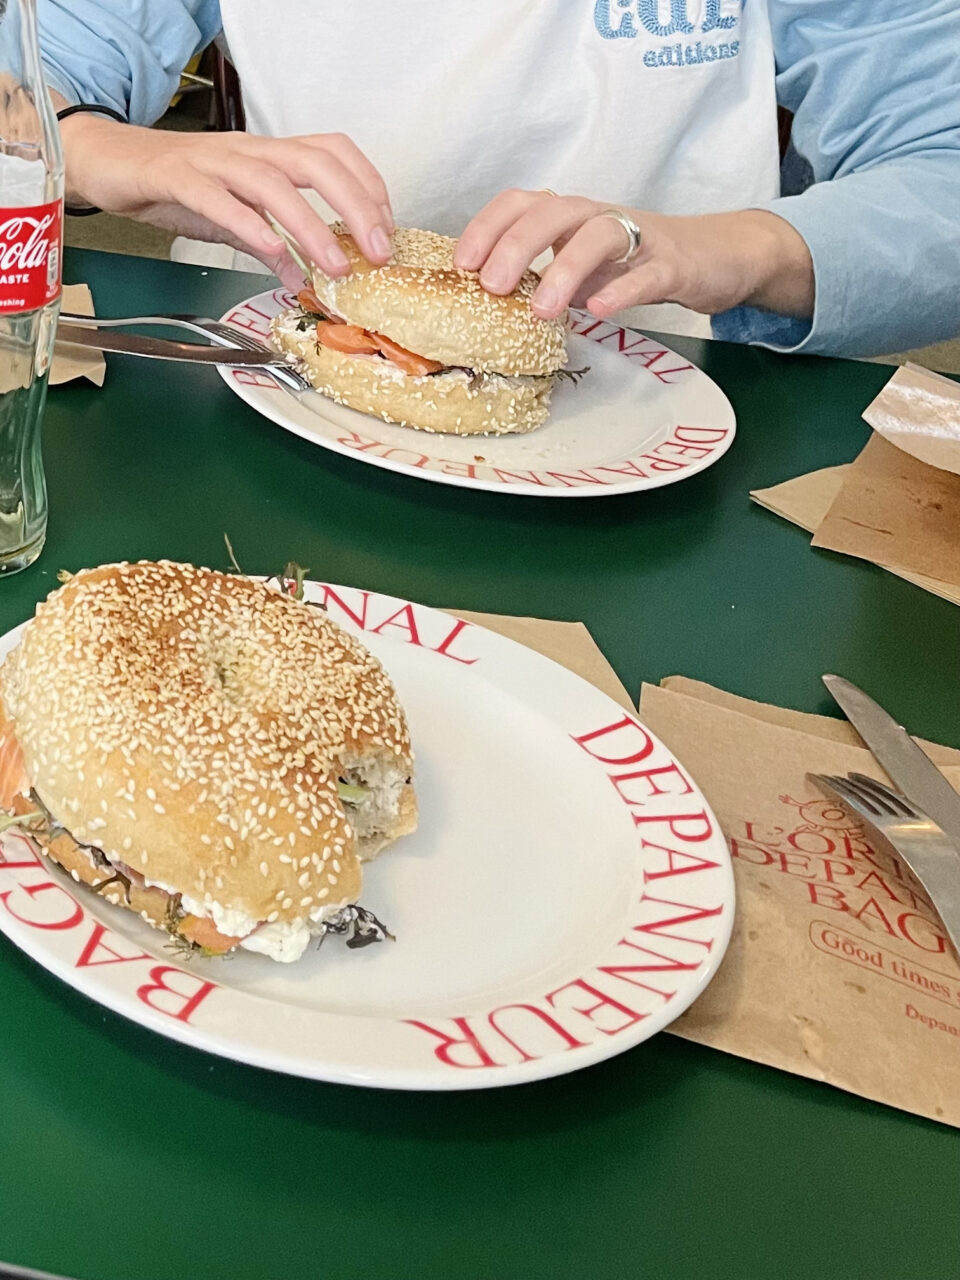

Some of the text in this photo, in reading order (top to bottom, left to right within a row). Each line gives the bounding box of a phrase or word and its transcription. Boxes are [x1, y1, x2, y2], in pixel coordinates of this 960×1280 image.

[336, 425, 729, 487] DEPANNEUR
[398, 712, 724, 1069] DEPANNEUR
[802, 881, 946, 954] BAG
[821, 929, 951, 998] Good times
[905, 1003, 960, 1038] Depan
